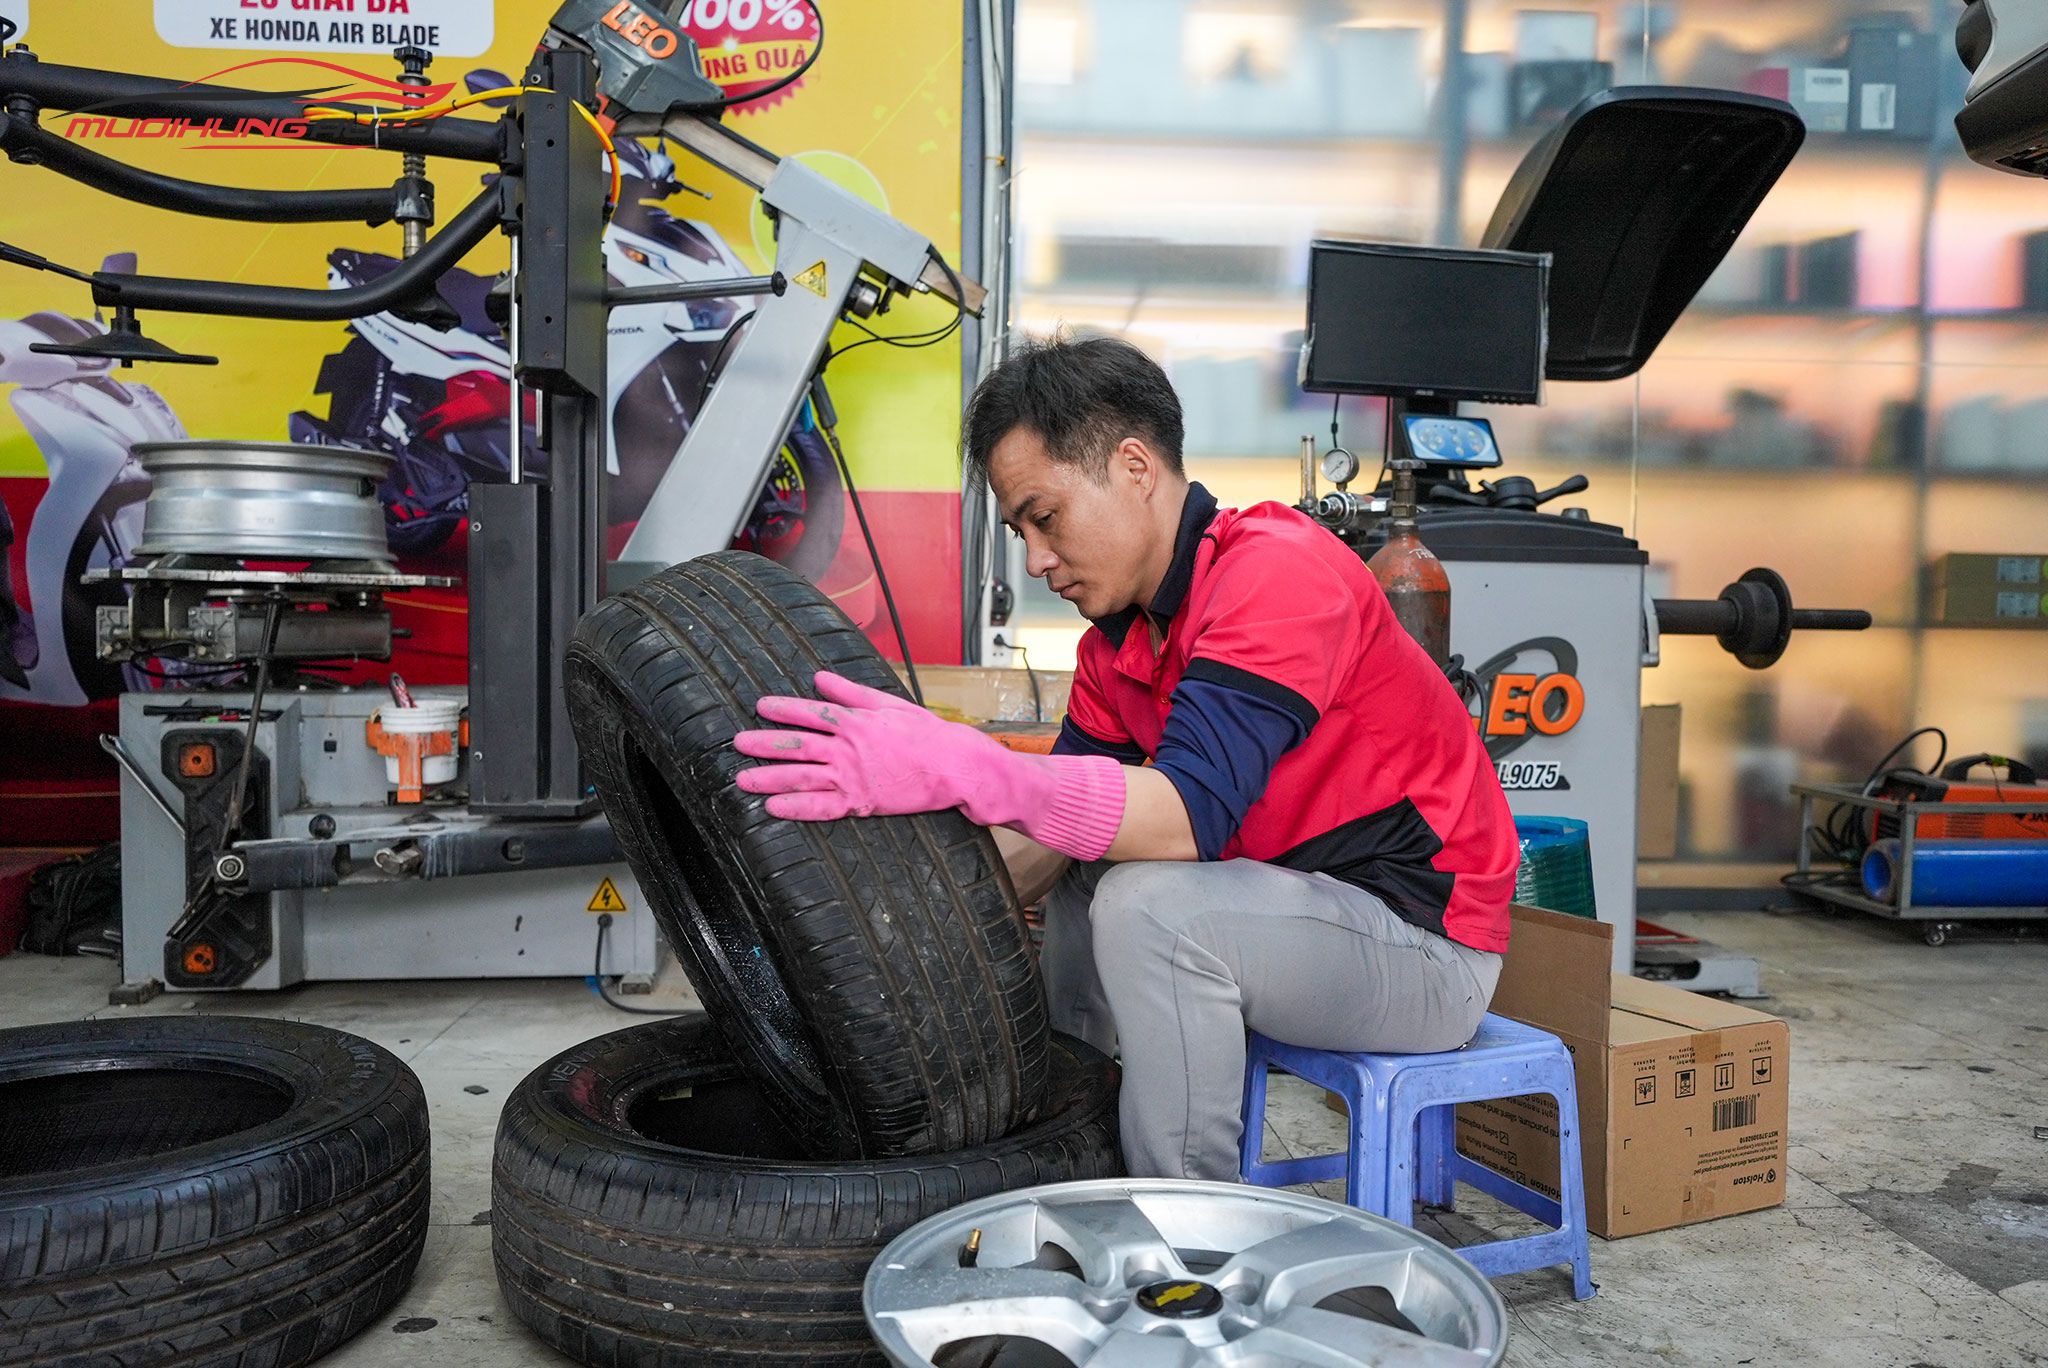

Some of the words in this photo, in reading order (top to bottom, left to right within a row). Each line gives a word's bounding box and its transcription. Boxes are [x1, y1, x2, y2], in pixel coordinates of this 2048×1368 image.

[601, 0, 678, 59] LEO
[679, 0, 804, 31] 100%
[210, 17, 237, 39] XE
[246, 18, 320, 42] HONDA
[328, 22, 364, 44] AIR
[372, 24, 439, 46] BLADE
[1472, 673, 1585, 735] EO
[1530, 1179, 1561, 1200] Holston
[1733, 1173, 1764, 1185] Holston
